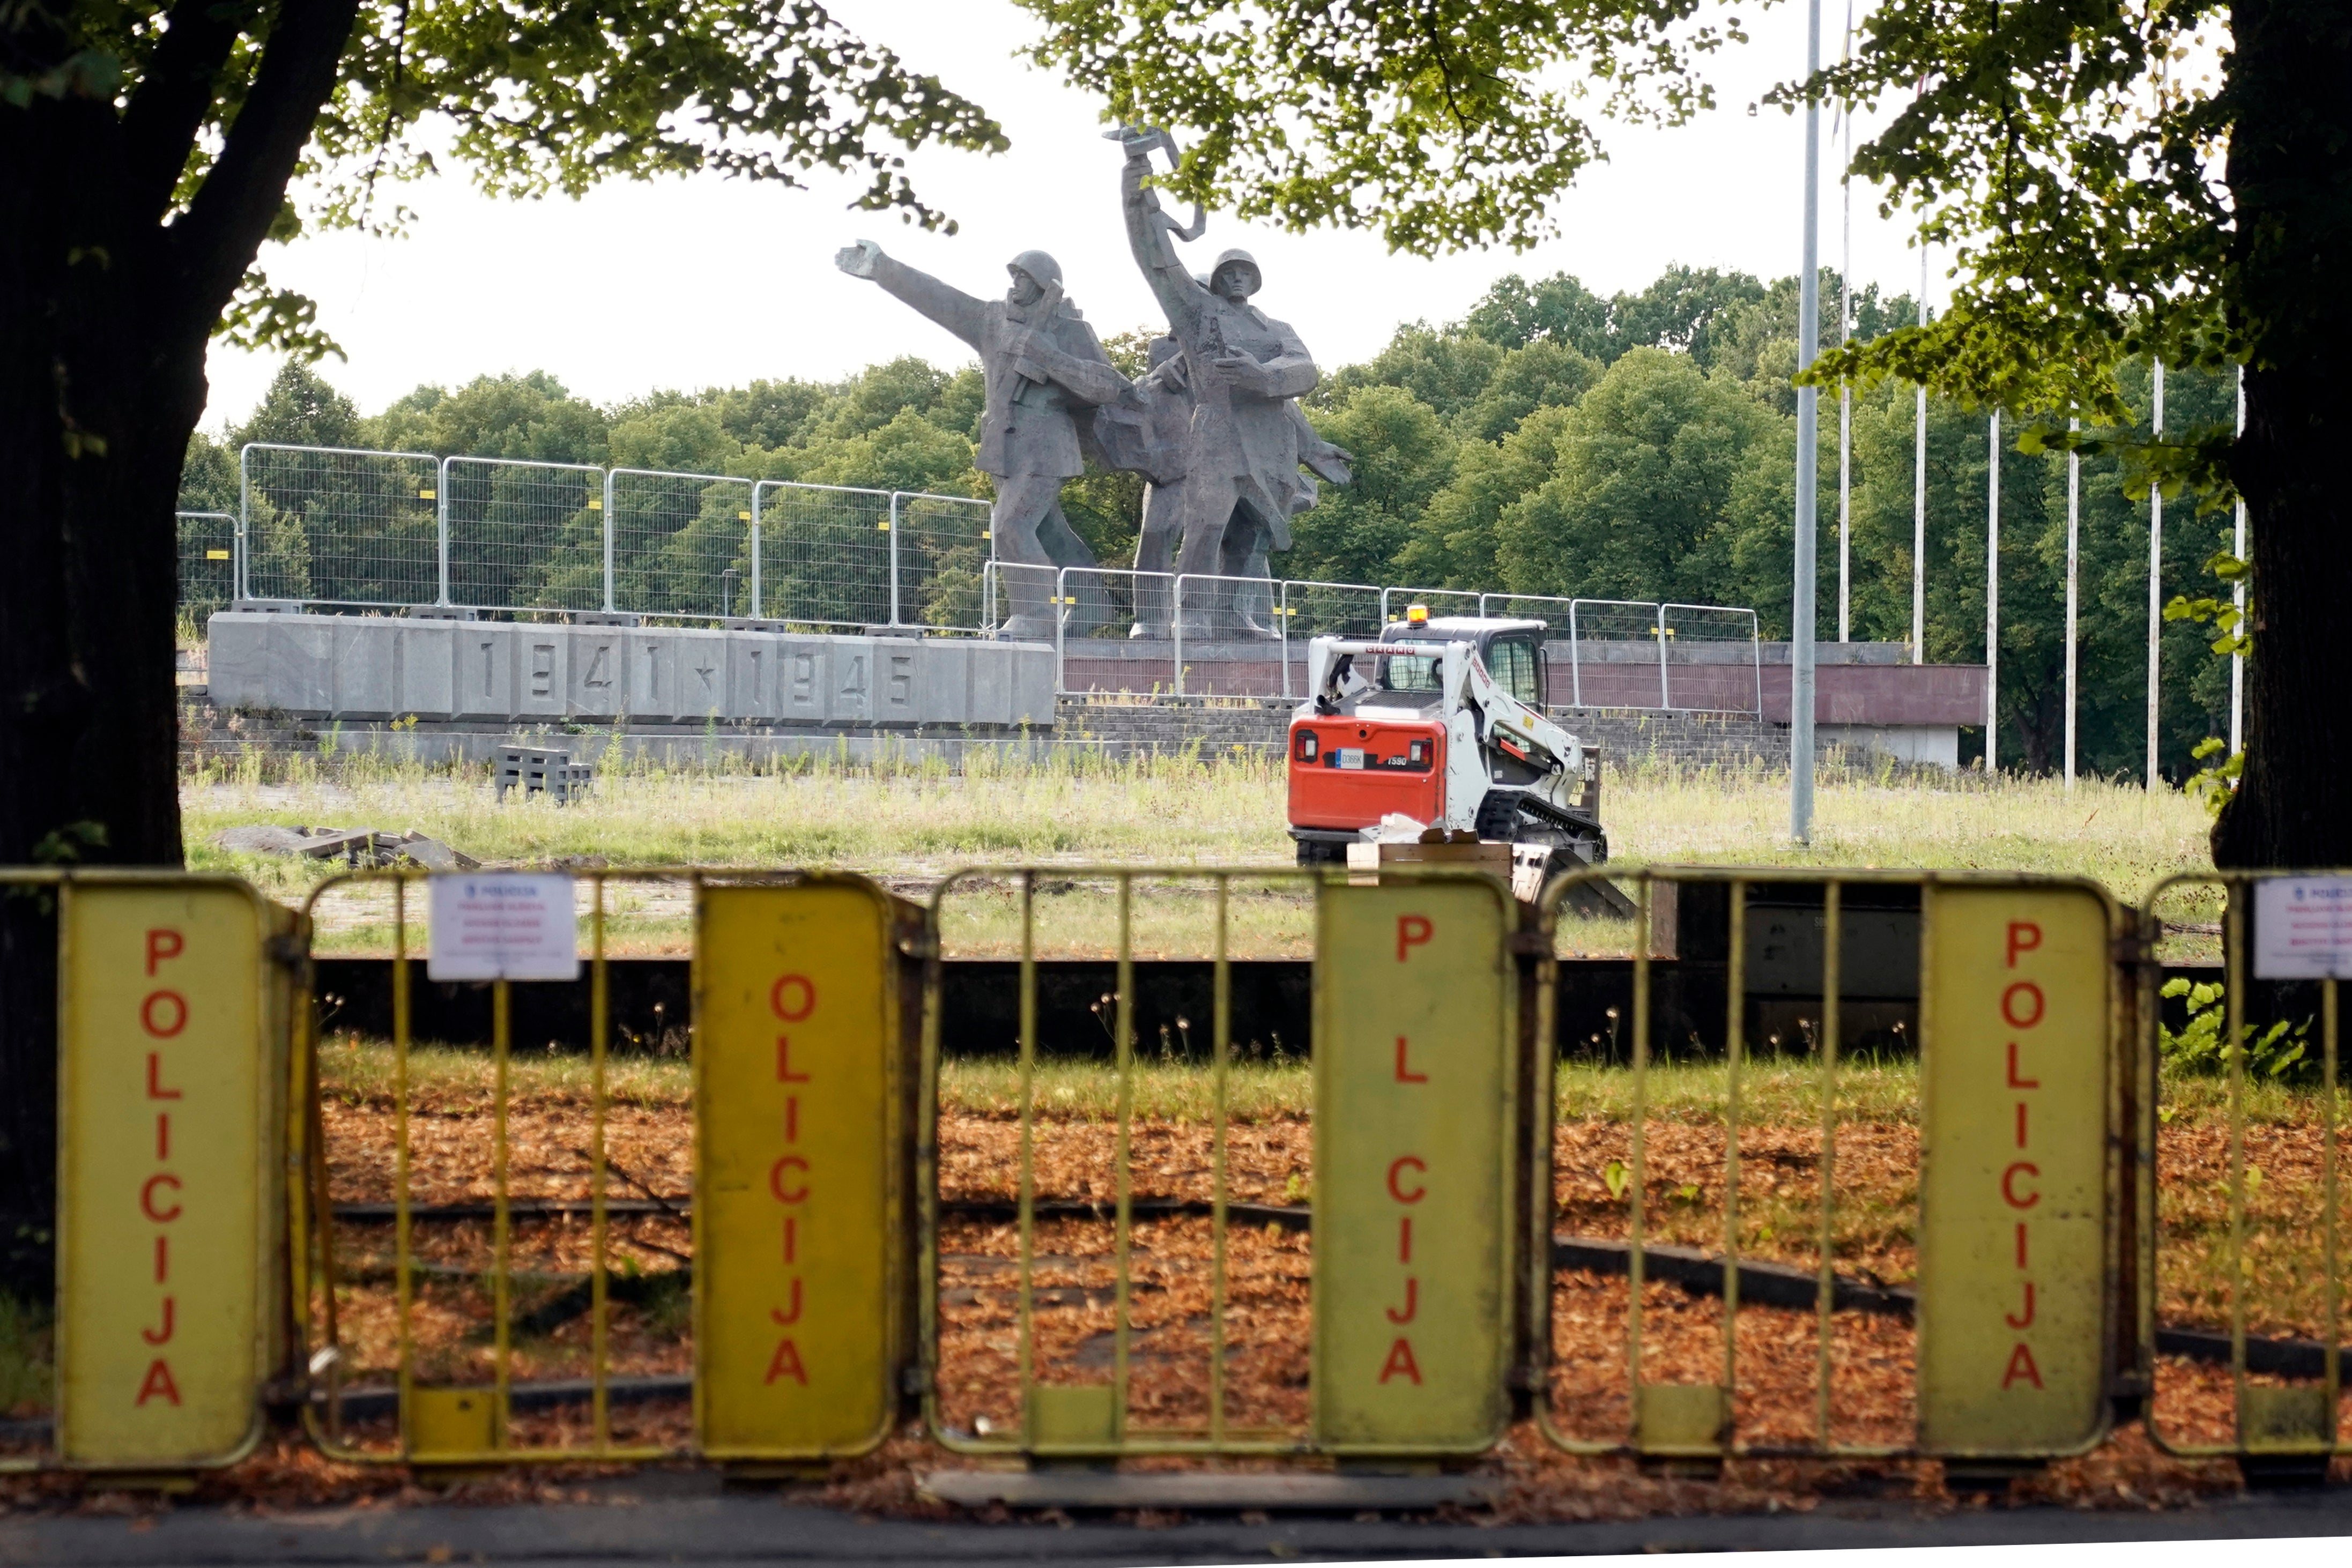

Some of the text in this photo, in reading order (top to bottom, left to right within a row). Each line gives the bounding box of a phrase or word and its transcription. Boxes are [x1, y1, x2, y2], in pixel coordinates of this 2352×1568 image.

[481, 643, 911, 708] 1941 1945
[135, 928, 189, 1407] POLICIJA
[765, 973, 818, 1386] OLICIJA
[2000, 921, 2046, 1389] POLICIJA
